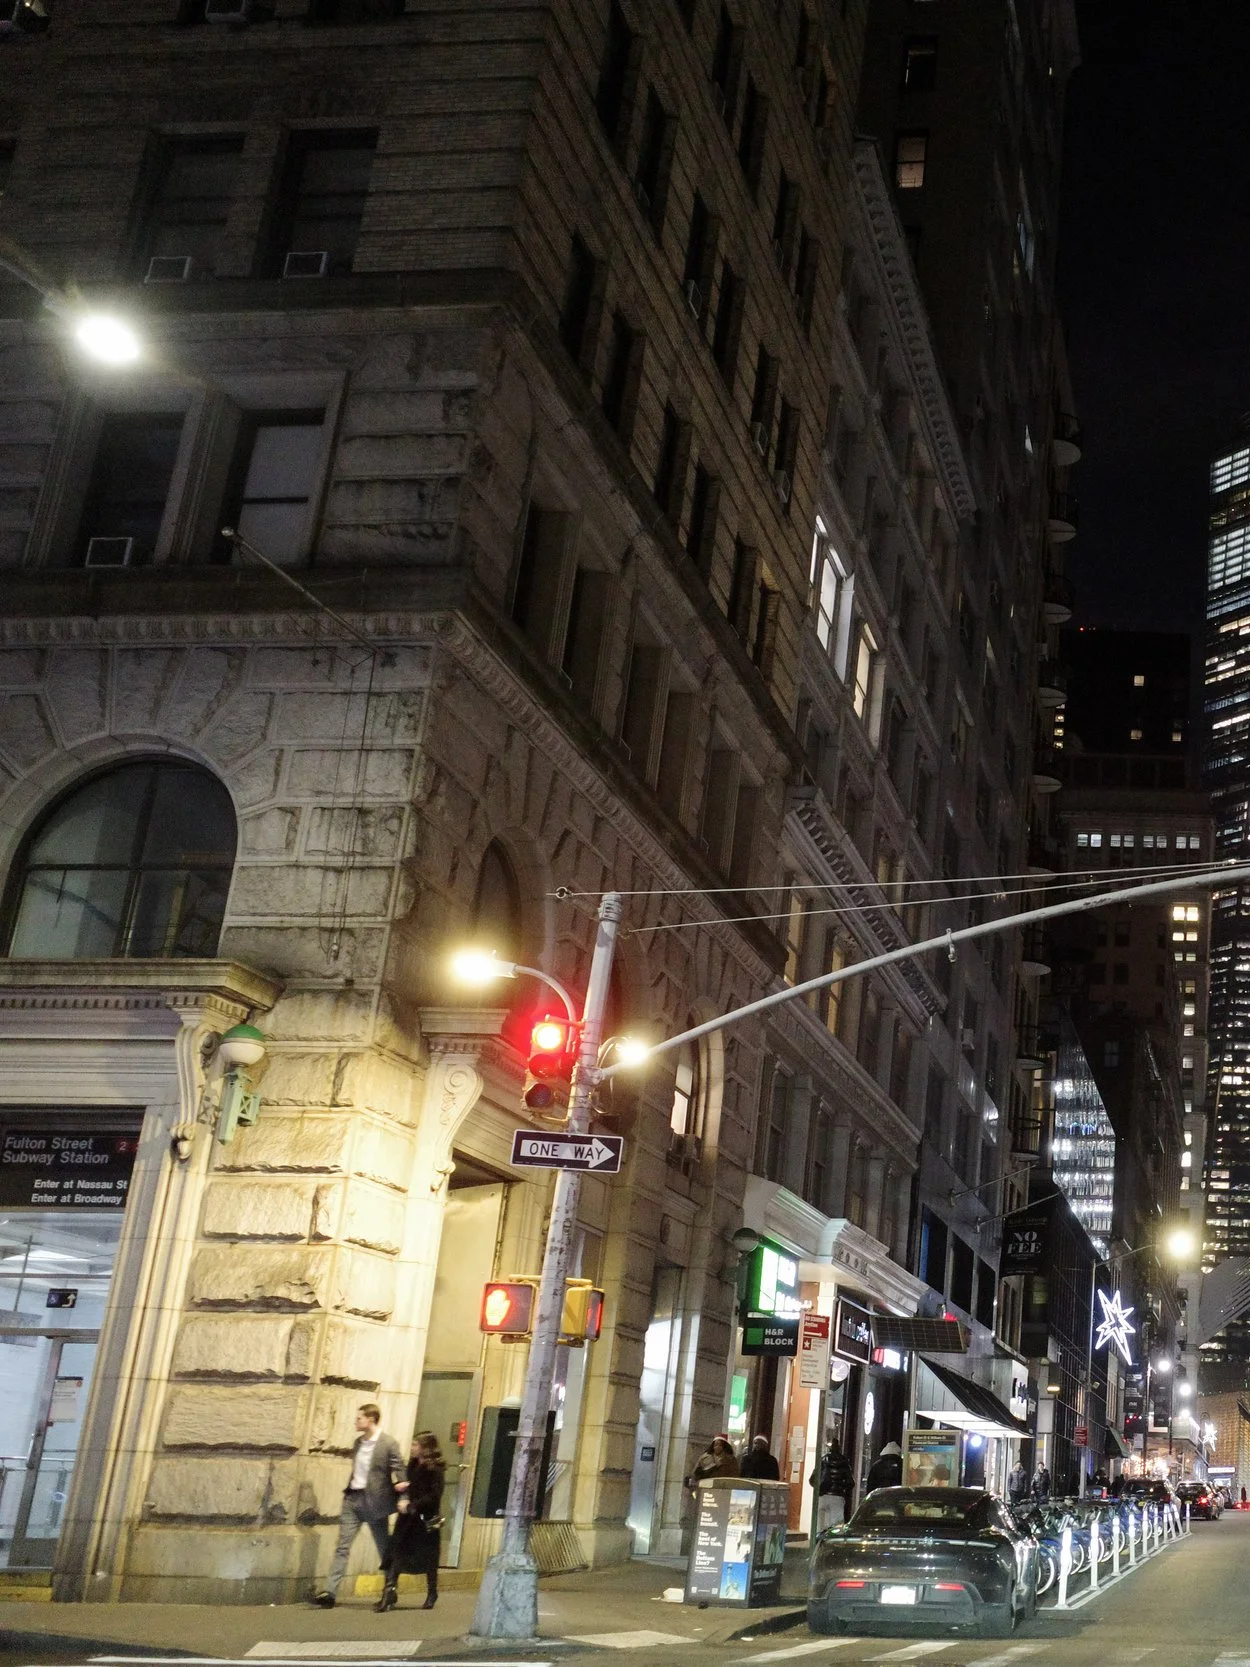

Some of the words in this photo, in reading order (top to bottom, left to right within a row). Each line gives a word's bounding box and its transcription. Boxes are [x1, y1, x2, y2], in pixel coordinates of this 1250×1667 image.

[4, 1137, 46, 1149] Fulton
[51, 1138, 94, 1149] Street
[119, 1141, 127, 1151] 2
[529, 1142, 560, 1157] ONE
[574, 1145, 605, 1160] WAY
[2, 1151, 56, 1165] Subway
[60, 1152, 109, 1163] Station
[33, 1180, 60, 1189] Enter
[63, 1181, 73, 1189] at
[76, 1180, 113, 1189] Nassau
[116, 1180, 128, 1189] St
[31, 1194, 57, 1202] Enter
[60, 1194, 71, 1202] at
[74, 1194, 122, 1205] Broadway
[1013, 1231, 1038, 1242] NO
[1007, 1242, 1042, 1254] FEE
[765, 1328, 784, 1336] H&R
[764, 1337, 794, 1346] BLOCK
